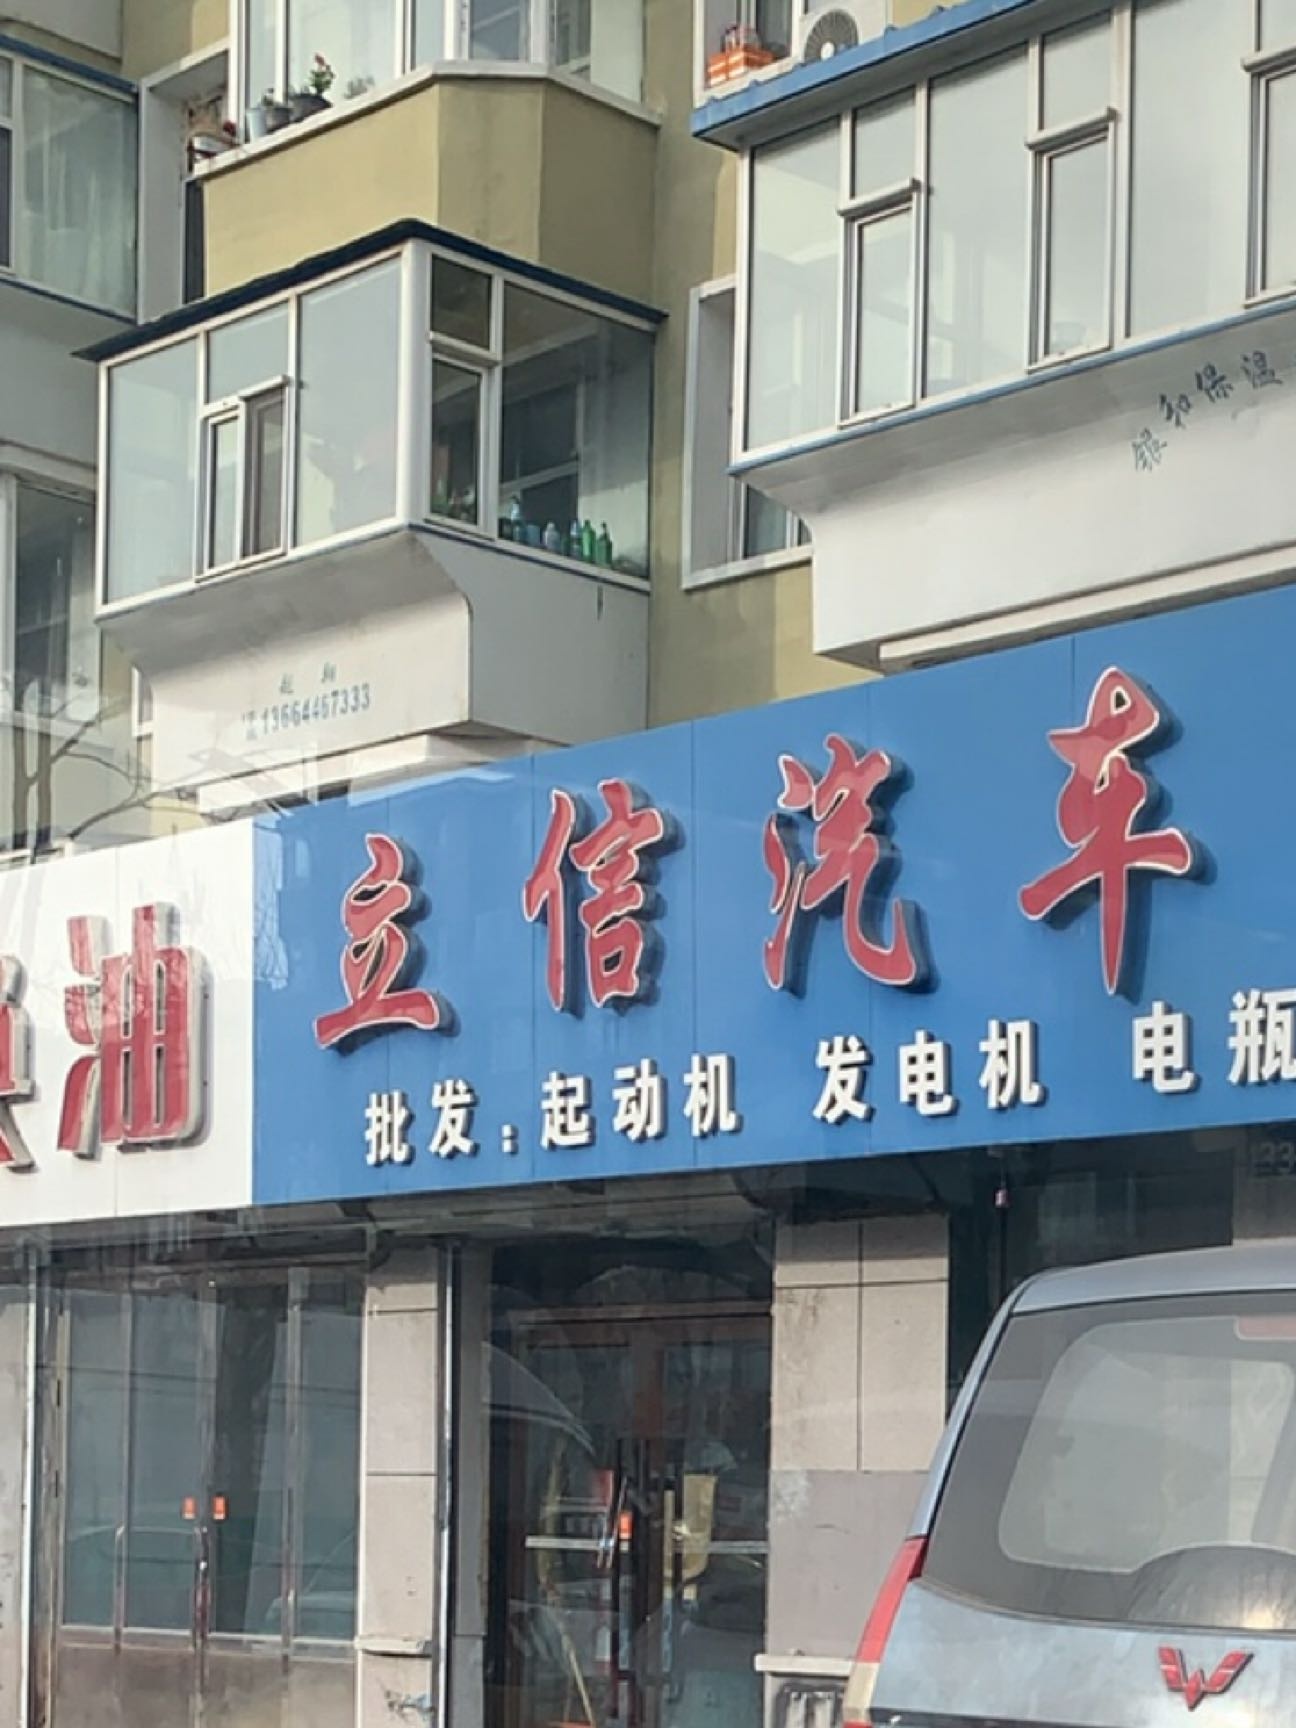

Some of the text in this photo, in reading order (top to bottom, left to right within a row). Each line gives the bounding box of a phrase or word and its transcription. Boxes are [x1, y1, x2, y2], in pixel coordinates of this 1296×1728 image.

[0, 903, 194, 1168] 油
[813, 1020, 1043, 1123] 发电机
